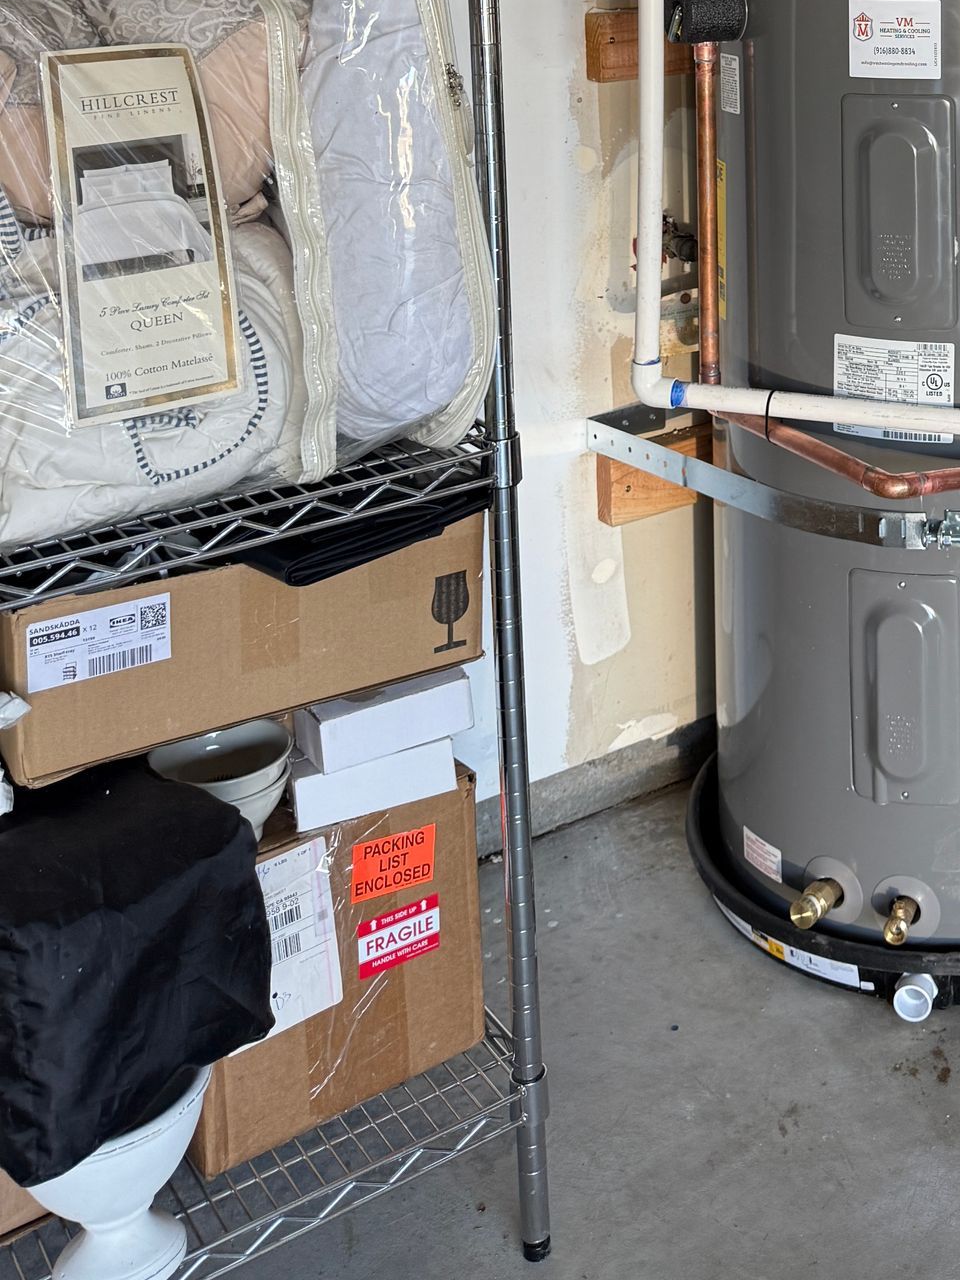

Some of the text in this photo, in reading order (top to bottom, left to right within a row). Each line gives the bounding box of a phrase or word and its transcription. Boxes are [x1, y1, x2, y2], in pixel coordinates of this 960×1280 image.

[896, 17, 913, 27] VM
[81, 89, 179, 113] HILLCREST
[110, 301, 160, 319] Piece Luxury
[130, 311, 184, 332] QUEEN
[105, 370, 132, 383] 100%
[134, 362, 170, 379] Cotton
[29, 617, 134, 636] SANDSKÅDDA IKEA
[32, 628, 78, 646] 005.594.46
[364, 831, 425, 860] PACKING
[379, 852, 410, 873] LIST
[354, 863, 431, 897] ENCLOSED
[381, 905, 417, 926] THIS SIDE UP
[366, 915, 434, 957] FRAGILE
[372, 938, 429, 968] HANDLE WITH CARE
